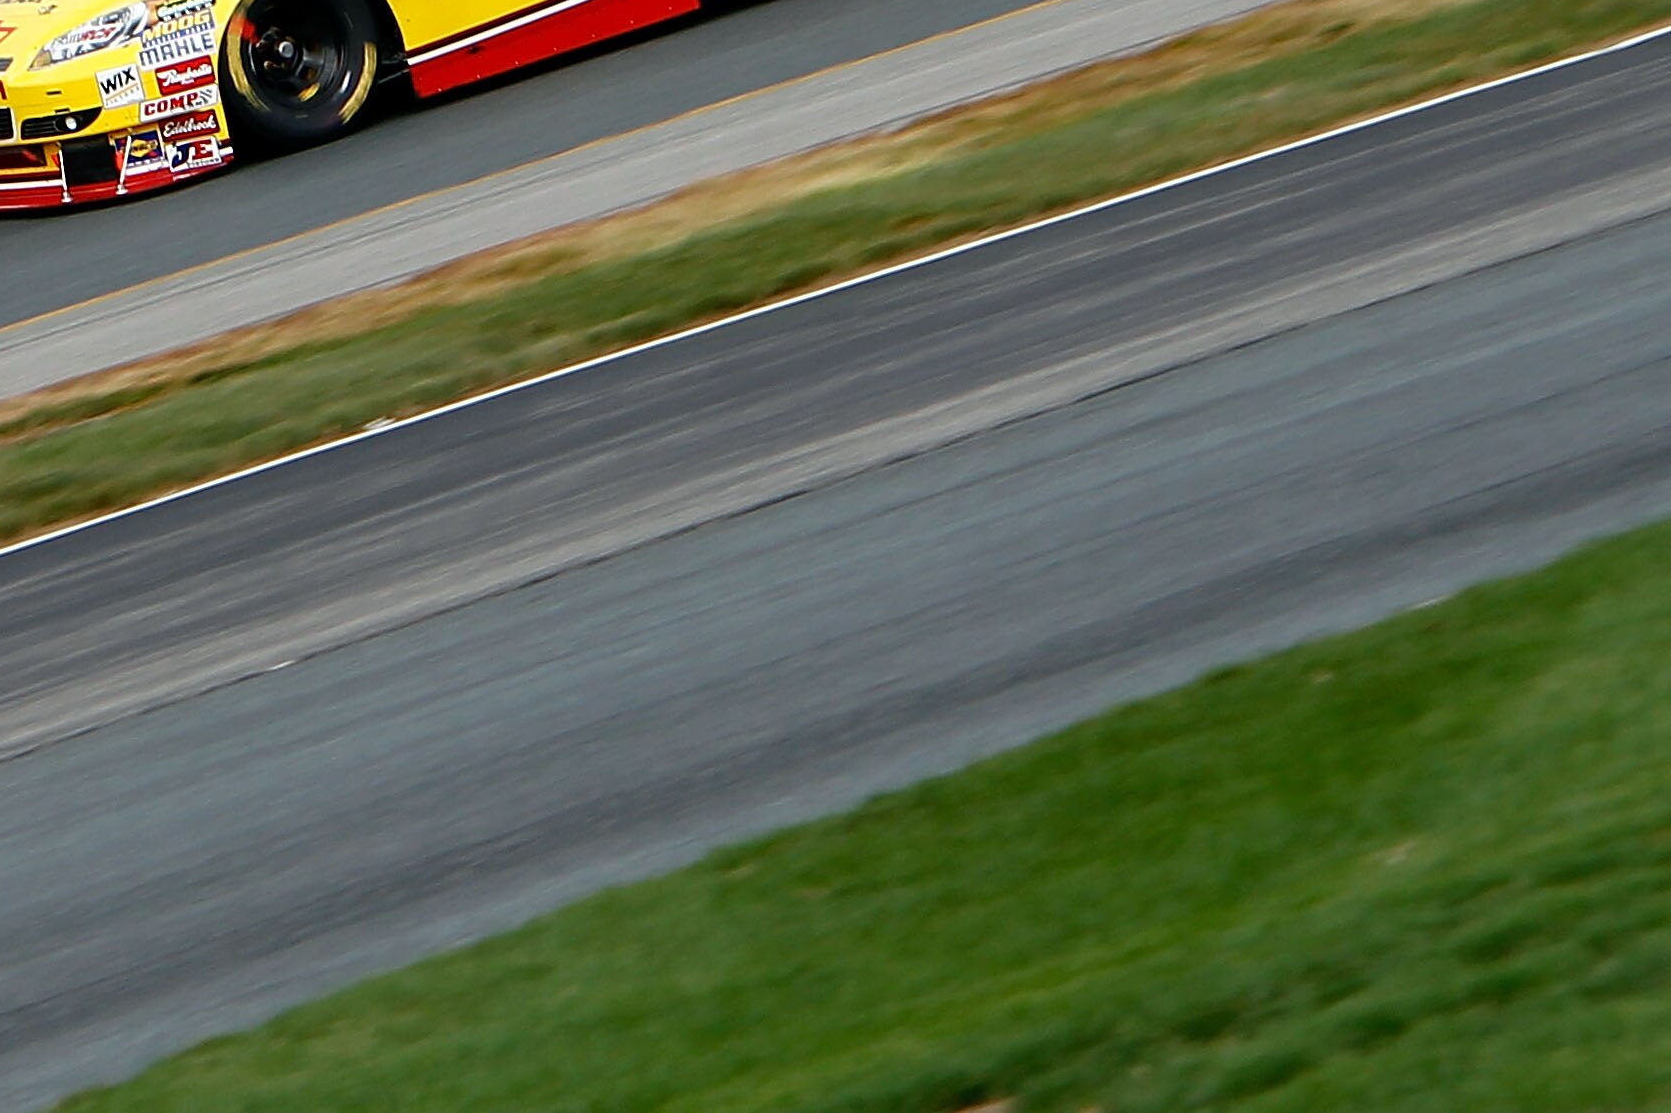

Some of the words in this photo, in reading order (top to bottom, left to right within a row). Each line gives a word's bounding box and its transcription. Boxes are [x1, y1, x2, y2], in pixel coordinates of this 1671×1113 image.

[142, 8, 211, 42] MOOG
[138, 32, 214, 67] MAHLE
[100, 66, 136, 95] WIX
[144, 91, 199, 116] COMP
[172, 139, 214, 168] JE
